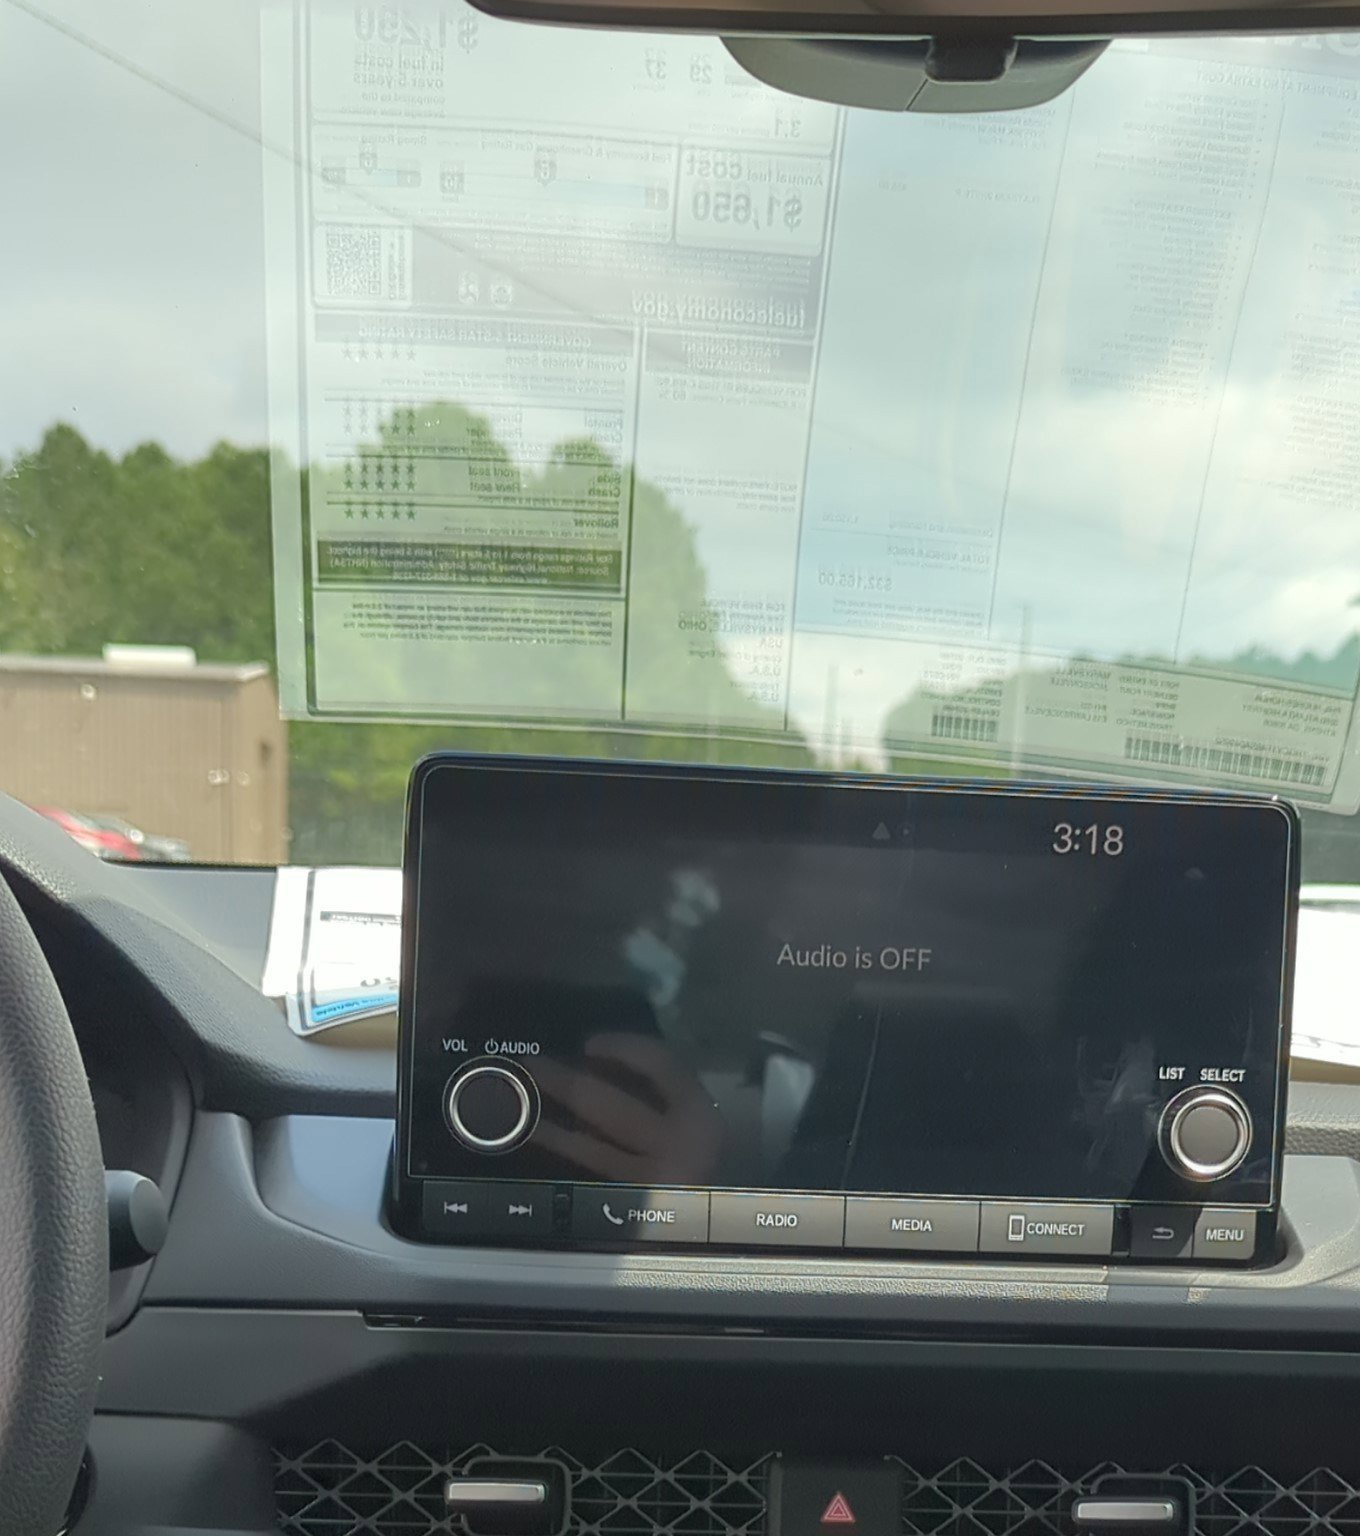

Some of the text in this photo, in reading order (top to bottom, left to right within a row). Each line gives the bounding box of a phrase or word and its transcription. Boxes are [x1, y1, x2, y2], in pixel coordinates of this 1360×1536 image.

[1052, 823, 1124, 856] 3:18
[776, 943, 932, 971] Audio is OFF
[442, 1037, 541, 1056] VOL AUDIO
[1158, 1066, 1246, 1084] LIST SELECT
[627, 1208, 676, 1226] PHONE
[755, 1212, 798, 1229] RADIO
[890, 1217, 933, 1234] MEDIA
[1026, 1221, 1085, 1238] CONNECT
[1205, 1227, 1245, 1243] MENU
